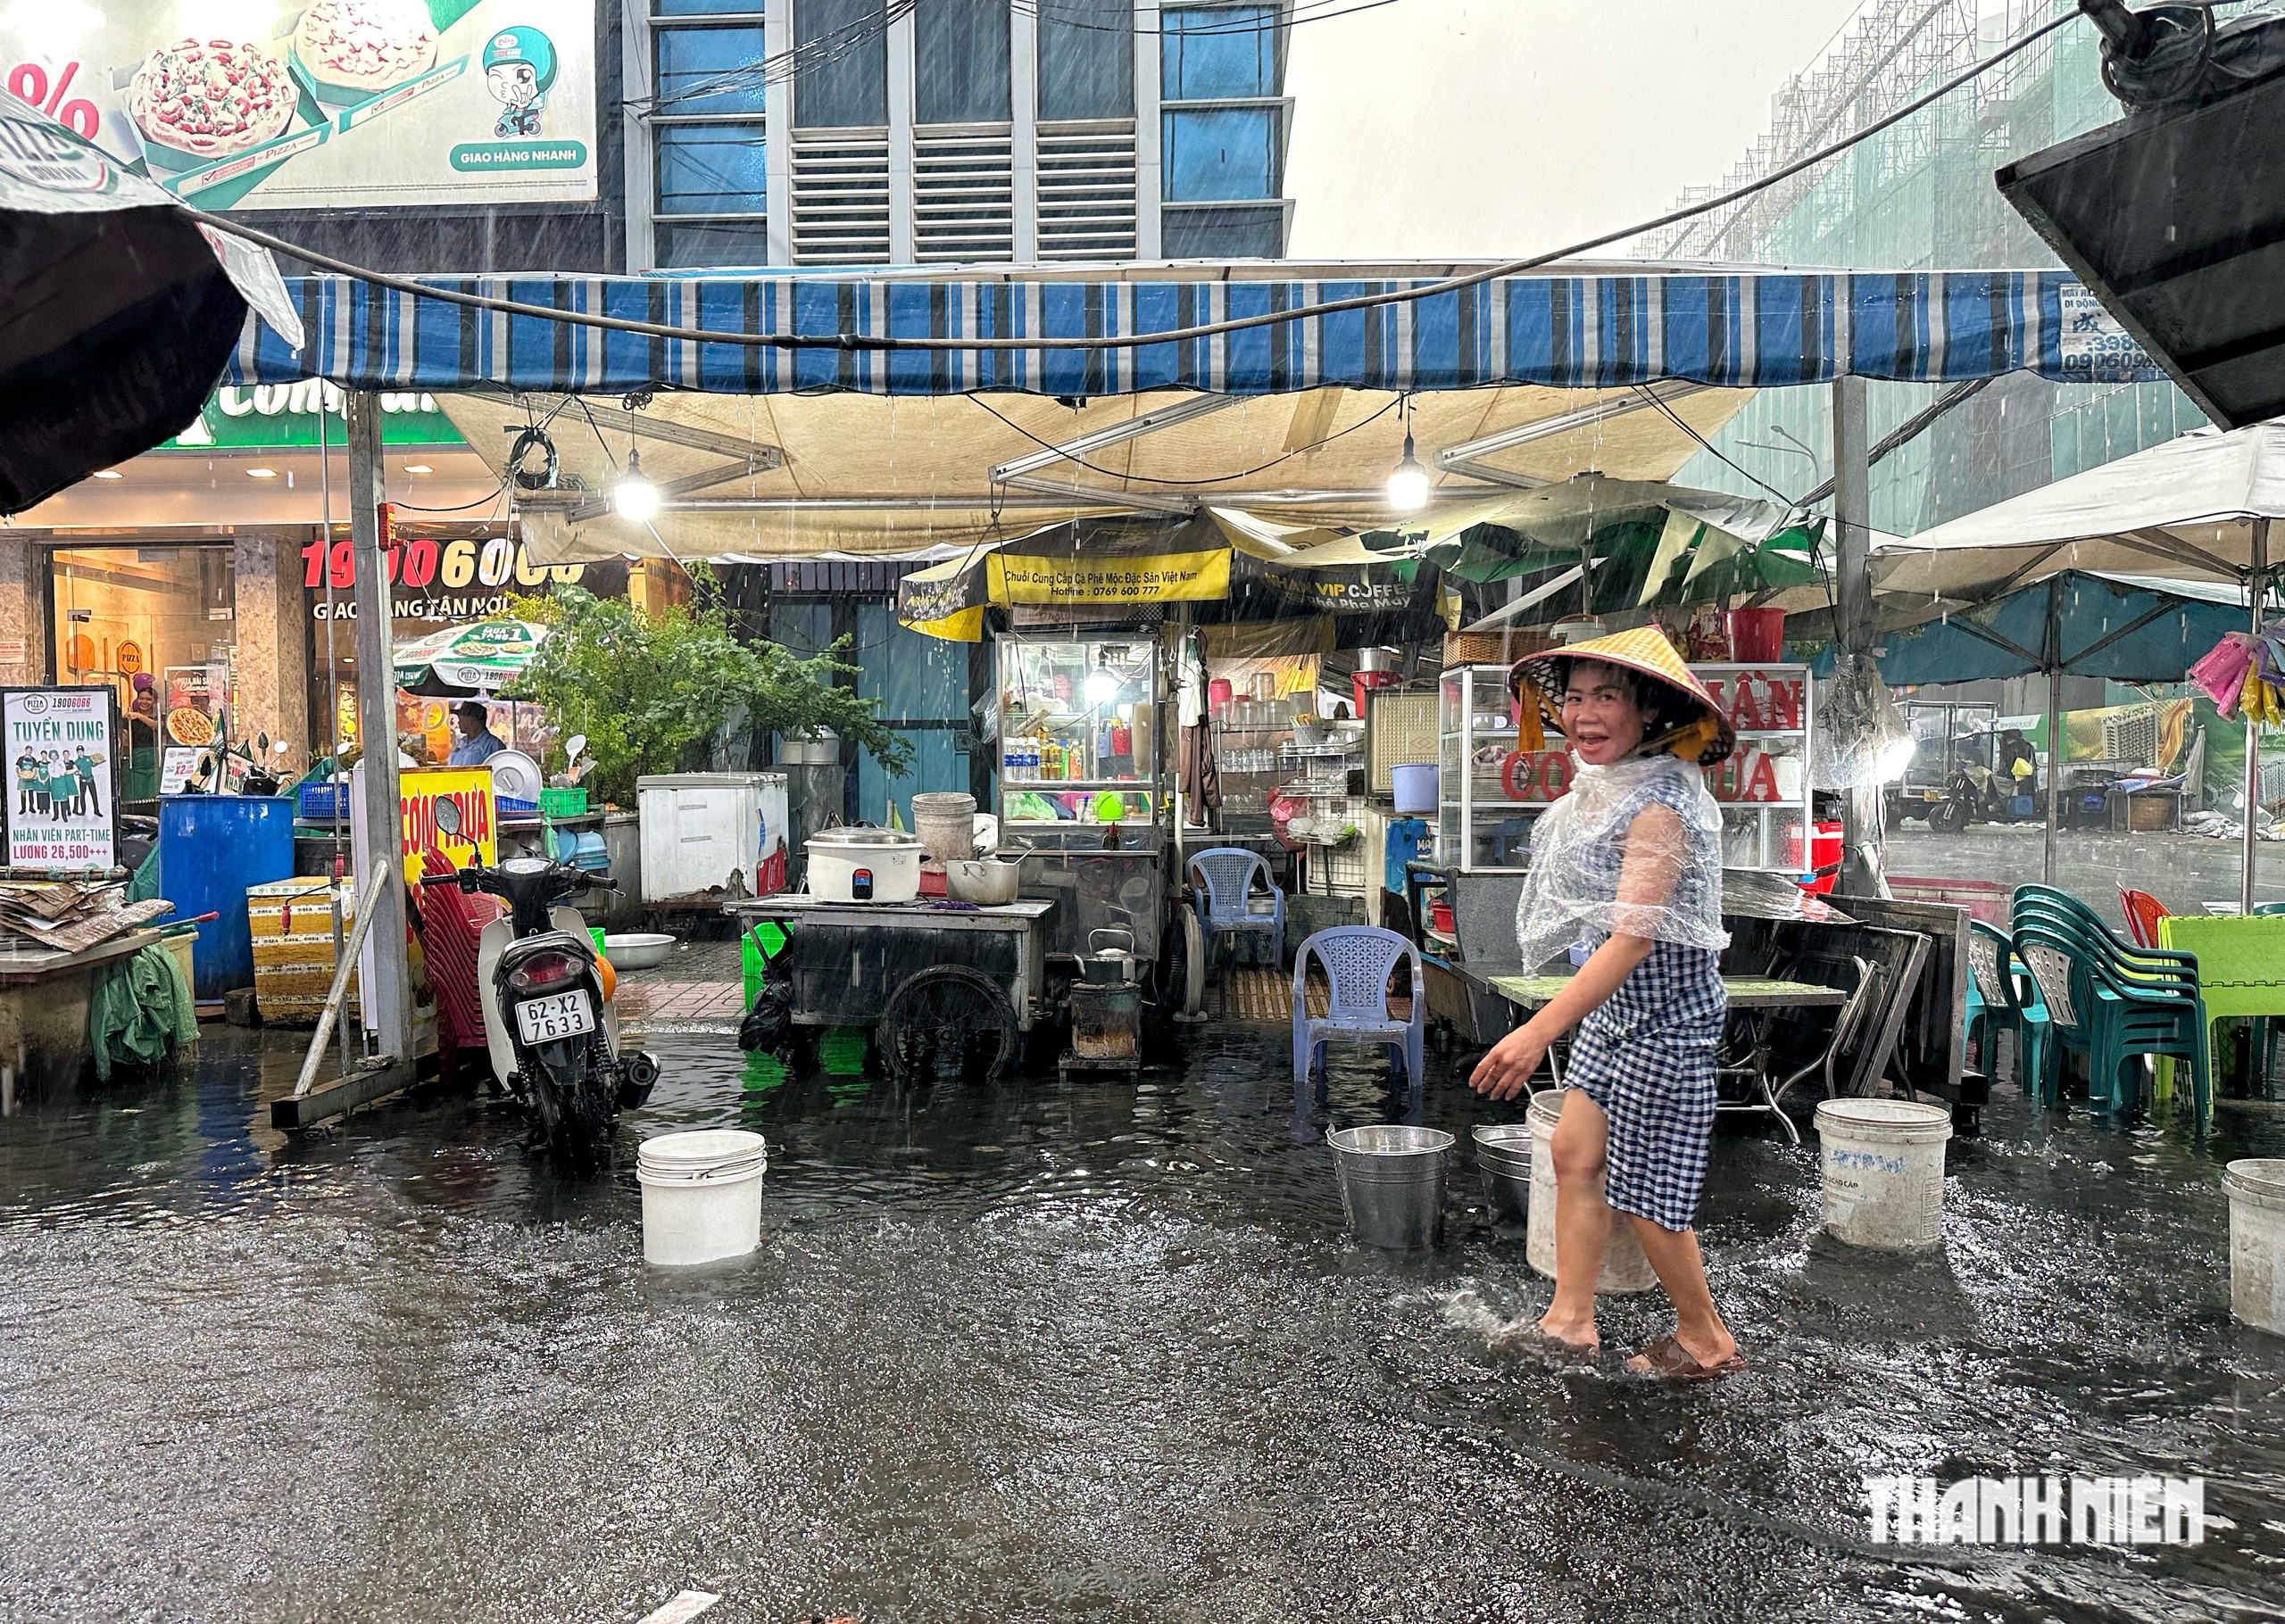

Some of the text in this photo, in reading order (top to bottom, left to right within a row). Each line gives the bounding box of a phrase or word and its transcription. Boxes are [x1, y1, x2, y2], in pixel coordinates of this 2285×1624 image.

[265, 142, 297, 160] PIZZA
[461, 148, 576, 163] GIAO HÀNG NHANH
[2065, 299, 2074, 309] DI
[1032, 572, 1054, 586] Cung
[1087, 572, 1104, 584] Phê
[1106, 572, 1123, 586] Mộc
[1125, 571, 1142, 586] Đặc
[1161, 569, 1178, 584] Việt
[1179, 570, 1198, 582] Nam
[1093, 586, 1117, 596] 0769
[1120, 586, 1139, 596] 600
[1142, 585, 1160, 595] 777
[1315, 581, 1347, 597] VIP
[1348, 582, 1419, 599] COFFEE
[1339, 597, 1370, 609] Pha
[1374, 595, 1411, 609] Máy
[121, 653, 140, 663] PIZZA
[460, 671, 477, 679] PIZZA
[27, 700, 44, 708] PIZZA
[1500, 742, 1577, 800] CƠ
[41, 827, 62, 841] VIÊN
[65, 828, 111, 841] PART-TIME
[13, 844, 108, 861] LƯƠNG 26,500+++
[531, 1014, 584, 1040] 7633
